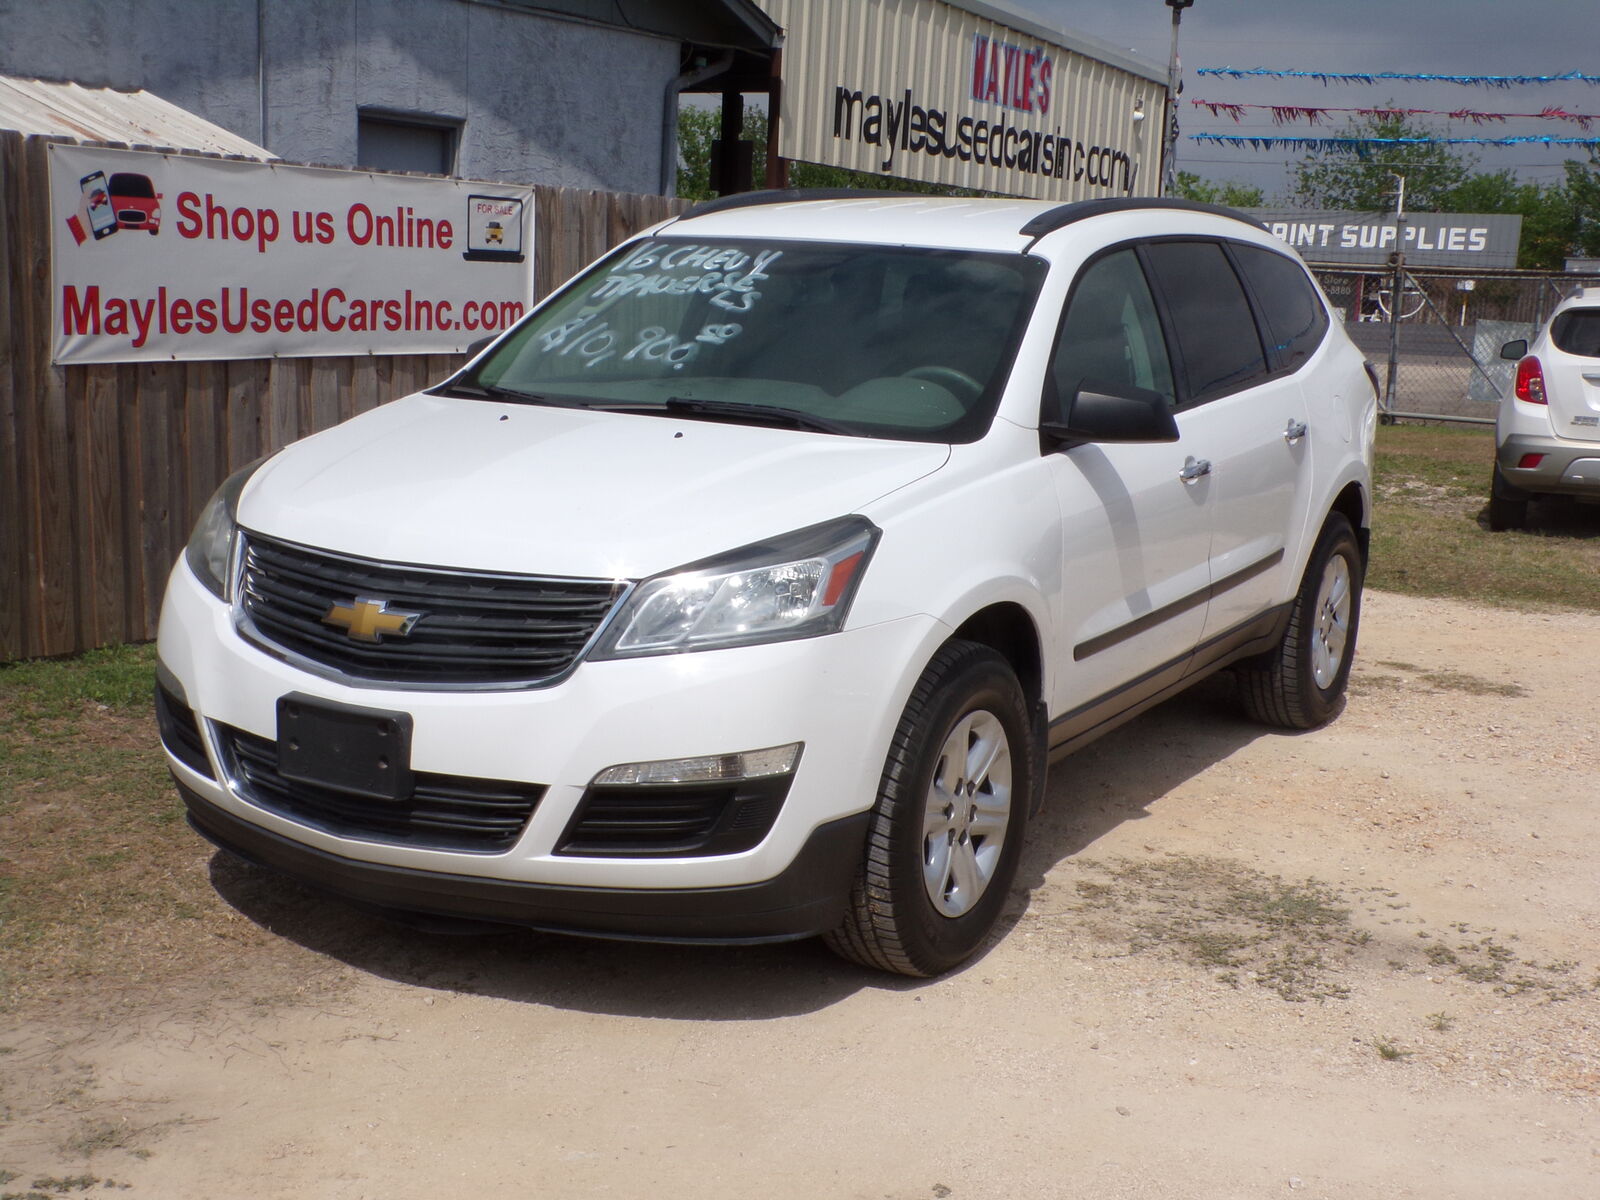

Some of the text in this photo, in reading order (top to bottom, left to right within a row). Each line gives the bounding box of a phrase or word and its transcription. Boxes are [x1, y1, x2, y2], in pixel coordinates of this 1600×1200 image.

[971, 33, 1052, 115] MAYLE'S
[834, 86, 1129, 191] maylesusedcarsinccom
[176, 191, 454, 253] Shop us Online
[477, 203, 513, 216] FOR SALE
[610, 241, 671, 271] 16
[1262, 222, 1335, 247] AINT
[62, 285, 524, 348] MaylesUsedCarsInc.com
[708, 289, 762, 313] LS
